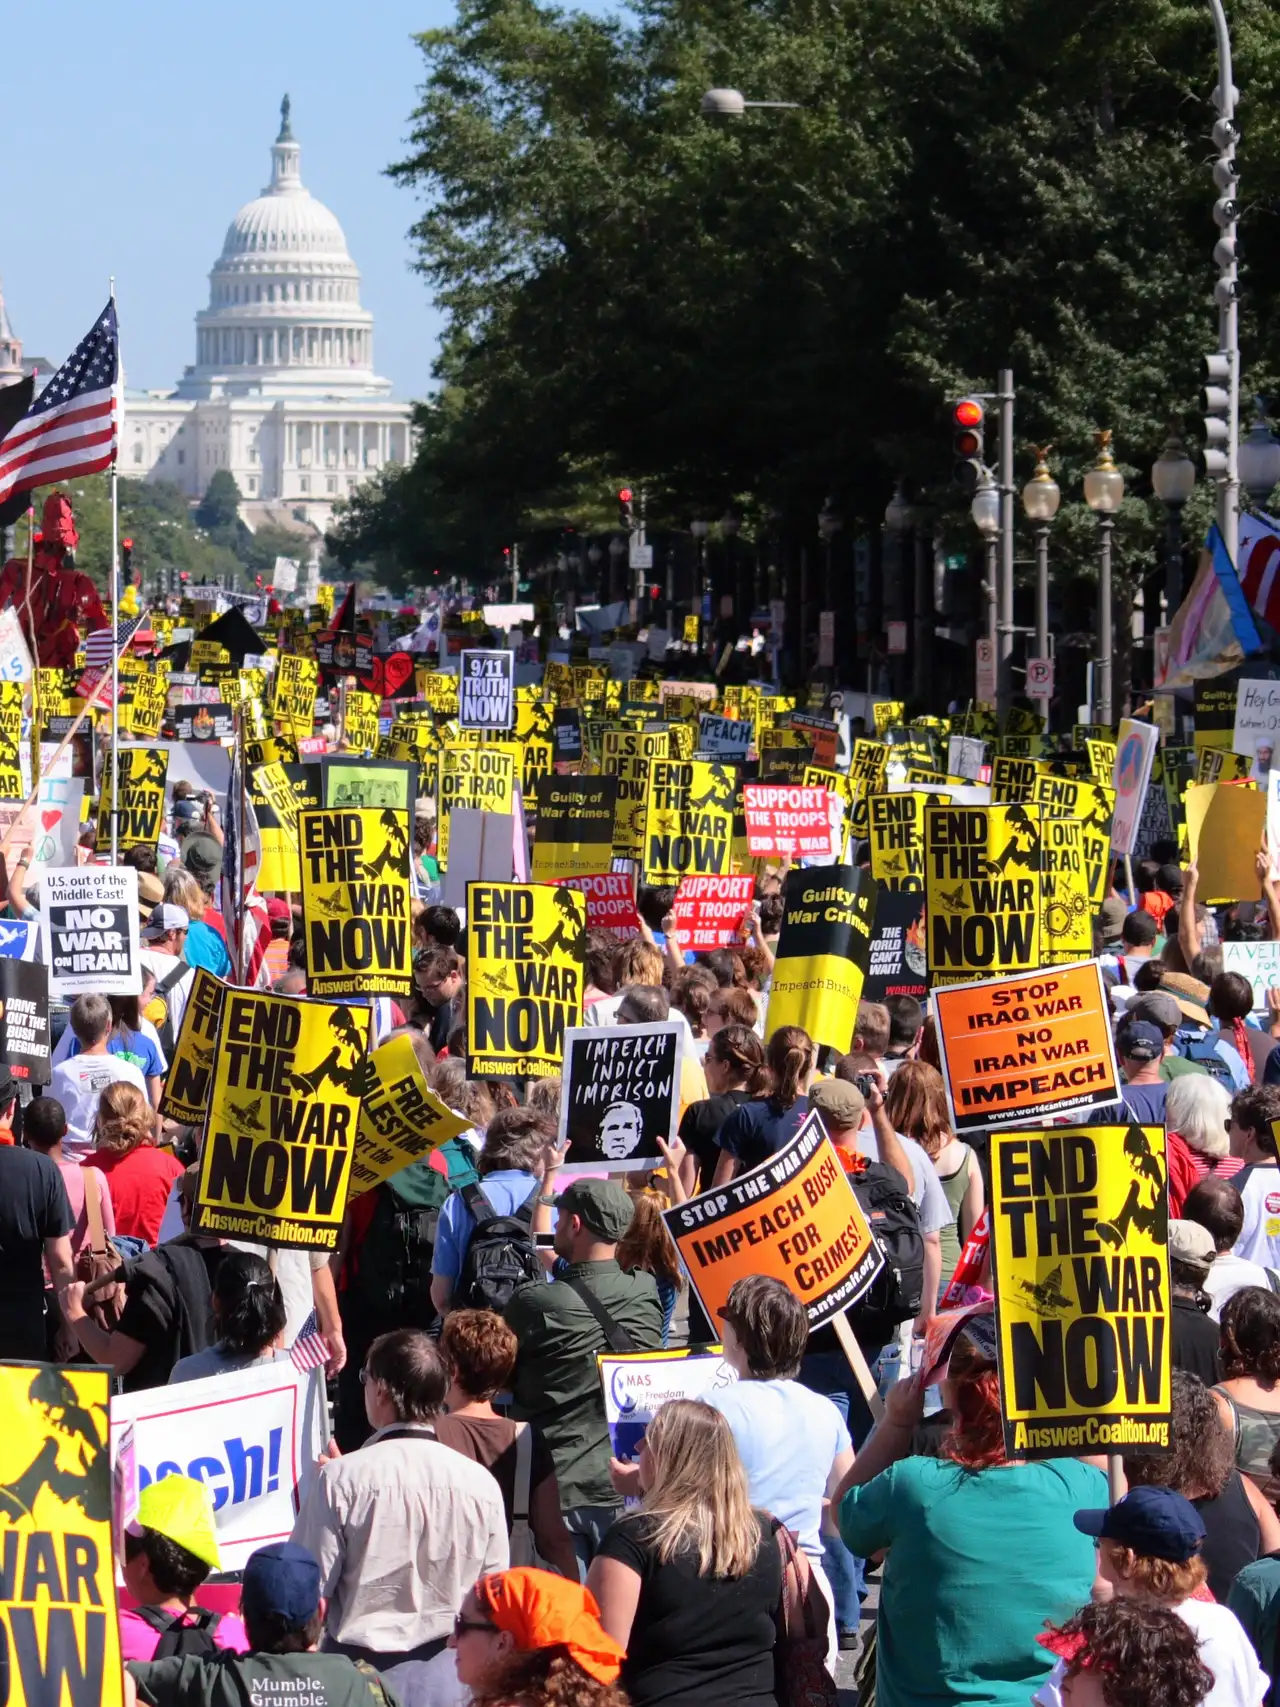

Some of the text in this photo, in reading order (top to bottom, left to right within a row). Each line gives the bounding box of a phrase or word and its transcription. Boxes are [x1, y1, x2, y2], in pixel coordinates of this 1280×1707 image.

[470, 659, 503, 677] 9/11
[464, 678, 508, 697] TRUTH
[464, 697, 509, 722] NOW
[653, 762, 693, 787] END
[541, 807, 610, 819] War Crimes
[550, 791, 602, 807] Guilty of
[654, 787, 691, 810] THE
[746, 787, 824, 809] SUPPORT
[306, 814, 362, 849] END
[680, 812, 727, 839] WAR
[747, 811, 826, 827] THE TROOPS
[930, 811, 988, 845] END
[649, 835, 727, 875] NOW
[750, 836, 773, 850] END
[801, 835, 829, 850] WAR
[304, 848, 364, 884] THE
[930, 846, 988, 880] THE
[47, 874, 127, 887] U.S. out of the
[52, 888, 123, 902] Middle East!
[347, 883, 405, 918] WAR
[473, 887, 534, 924] END
[802, 886, 868, 911] Guilty of
[970, 879, 1033, 913] WAR
[64, 908, 114, 930] NO
[788, 909, 870, 939] War Crimes
[58, 931, 123, 951] WAR
[312, 918, 406, 973] NOW
[473, 925, 533, 960] THE
[931, 913, 1034, 967] NOW
[54, 953, 128, 972] ON IRAN
[312, 976, 410, 996] AnswerCoalition.org
[515, 961, 577, 1003] WAR
[992, 980, 1059, 1006] STOP
[6, 998, 37, 1015] DRIVE
[968, 995, 1082, 1030] IRAQ WAR
[6, 1013, 46, 1031] OUT THE
[6, 1027, 36, 1041] BUSH
[228, 998, 302, 1050] END
[474, 996, 578, 1054] NOW
[6, 1039, 49, 1059] REGIME!
[586, 1034, 667, 1060] IMPEACH
[1016, 1028, 1053, 1047] NO
[225, 1043, 296, 1096] THE
[592, 1059, 659, 1081] INDICT
[974, 1038, 1090, 1073] IRAN WAR
[575, 1075, 671, 1105] IMPRISON
[961, 1061, 1106, 1106] IMPEACH
[390, 1075, 443, 1130] FREE
[269, 1095, 351, 1148] WAR
[206, 1132, 345, 1217] NOW
[680, 1125, 820, 1227] STOP THE WAR NOW!
[1000, 1136, 1098, 1198] END
[199, 1206, 338, 1247] AnswerCoalition.org
[690, 1156, 839, 1268] IMPEACH BUSH
[1000, 1196, 1101, 1259] THE
[778, 1222, 822, 1266] FOR
[793, 1214, 862, 1290] CRIMES!
[1072, 1256, 1163, 1315] WAR
[1011, 1316, 1164, 1412] NOW
[626, 1374, 652, 1387] MAS
[645, 1390, 685, 1400] Freedom
[1014, 1415, 1169, 1450] AnswerCoalition.org
[251, 1692, 328, 1707] Grumble.
[252, 1678, 325, 1693] Mumble.
